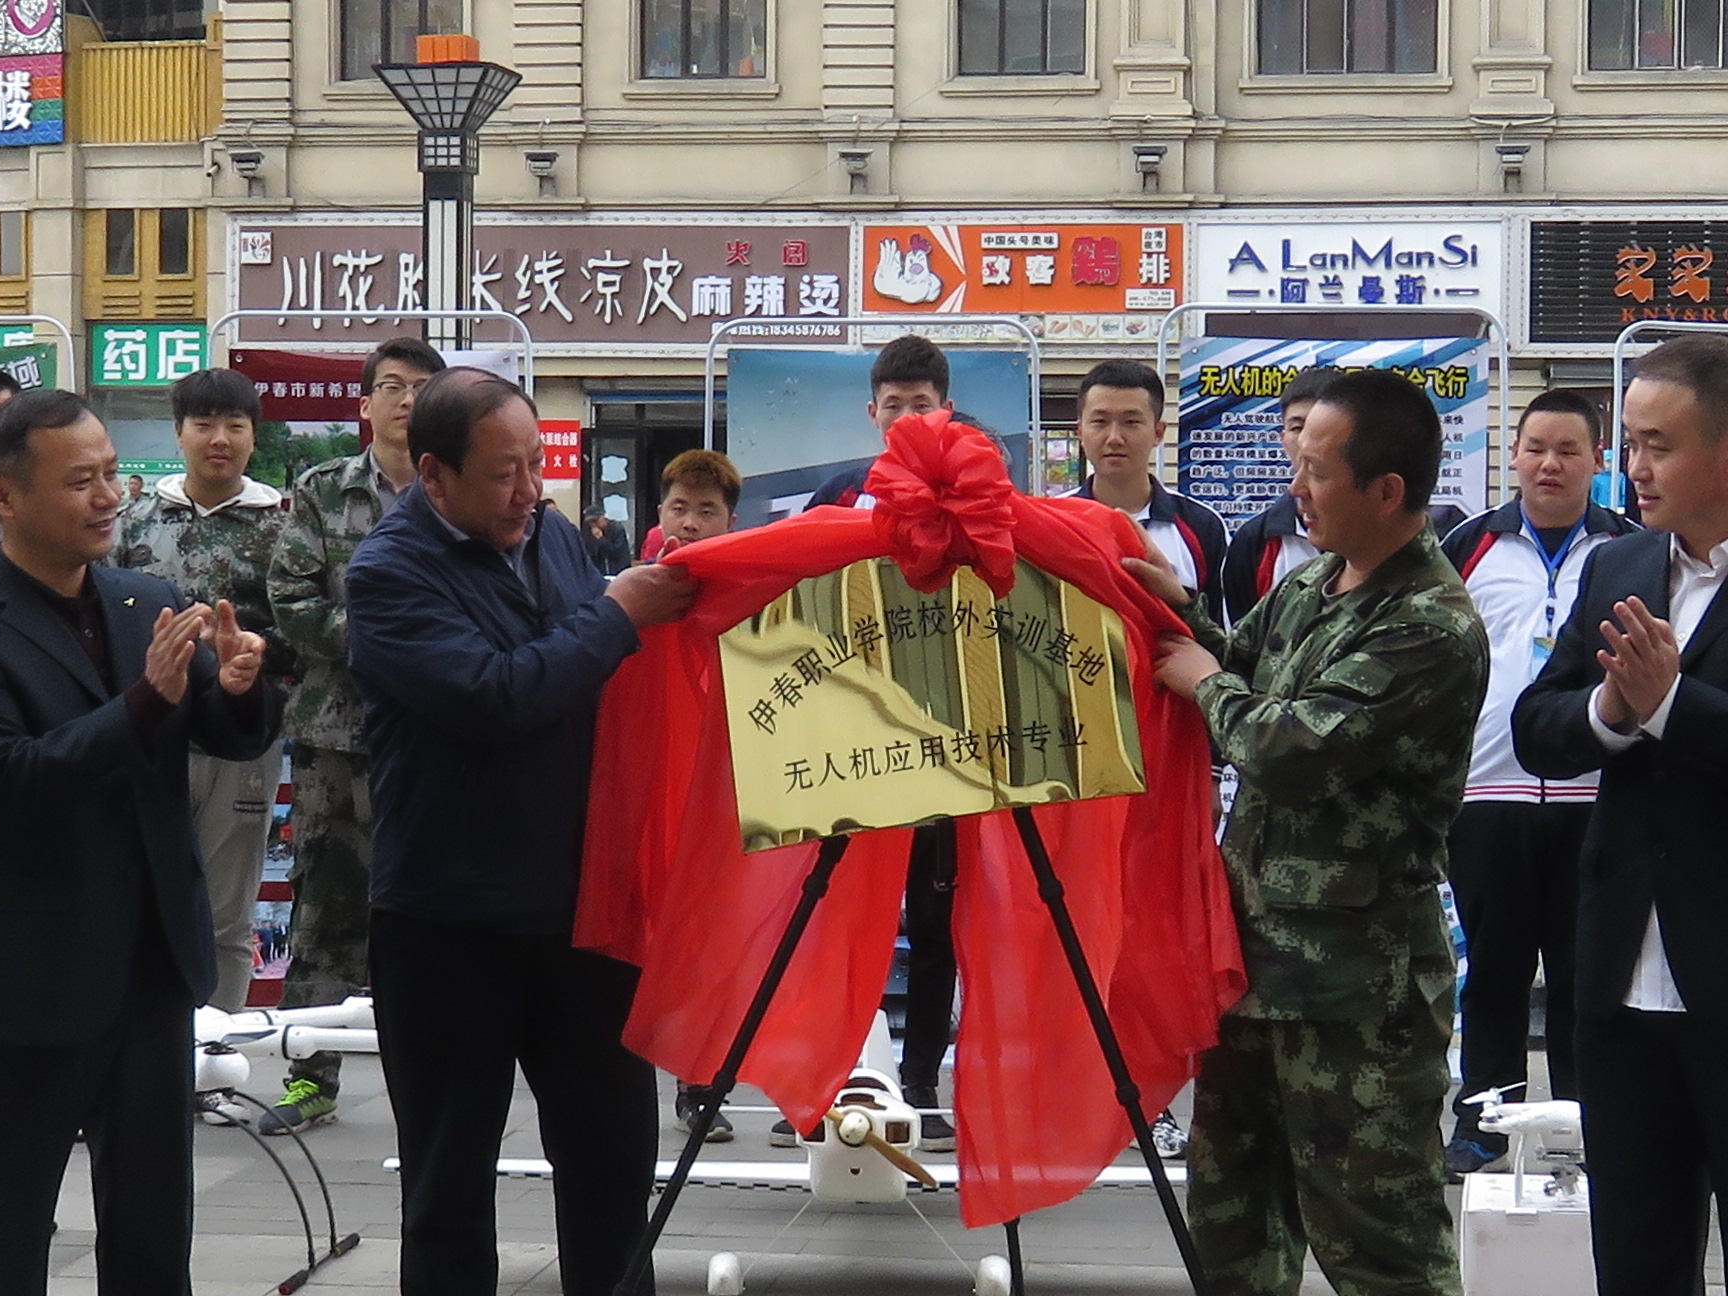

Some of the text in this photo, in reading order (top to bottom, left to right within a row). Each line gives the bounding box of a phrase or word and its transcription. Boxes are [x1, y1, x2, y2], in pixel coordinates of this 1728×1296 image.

[983, 235, 1056, 246] 中国头号美味
[691, 273, 841, 317] 麻辣烫
[1280, 274, 1427, 304] 阿兰曼斯
[102, 329, 202, 381] 药店
[254, 380, 362, 398] 伊春市新希望
[1191, 429, 1283, 443] 速发展的新兴产业
[747, 599, 1106, 735] 伊春职业学院校外实训基地
[783, 717, 1088, 794] 无人机应用技术专业
